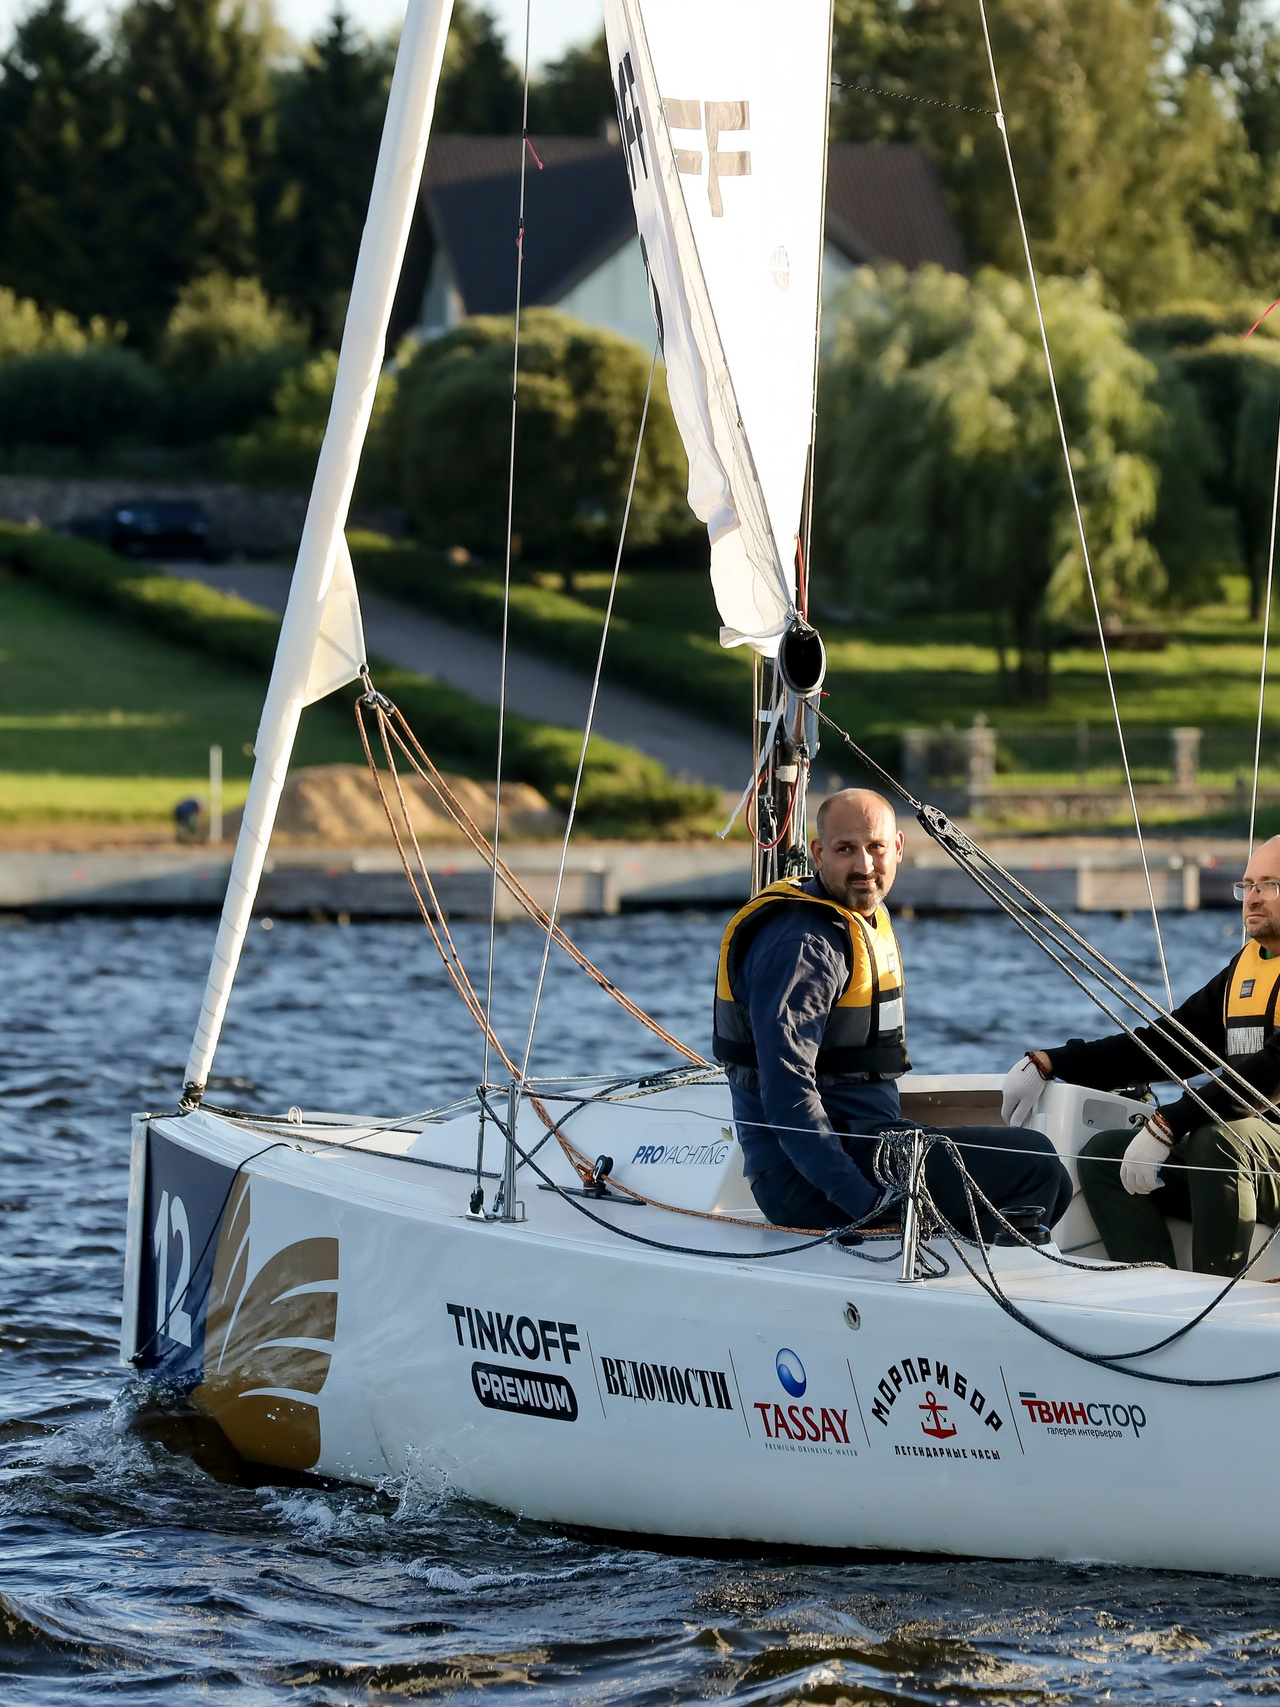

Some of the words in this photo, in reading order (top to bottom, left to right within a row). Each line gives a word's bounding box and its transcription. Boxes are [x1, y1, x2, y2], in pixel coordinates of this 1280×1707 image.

[631, 1145, 729, 1164] PROYACHTING
[153, 1189, 192, 1348] 12
[446, 1302, 581, 1365] TINKOFF
[476, 1370, 572, 1413] PREMIUM
[600, 1355, 734, 1411] ВЕДОМОСТИ
[871, 1356, 1003, 1432] МОРПРИБОР
[753, 1402, 851, 1444] TASSAY
[1046, 1426, 1077, 1436] галерея
[1078, 1428, 1123, 1439] интерьеров
[765, 1442, 796, 1452] PREMIUM
[798, 1445, 833, 1455] DRINKING
[836, 1448, 859, 1457] WATER
[894, 1445, 968, 1459] ЛЕГЕНДАРНЫЕ
[971, 1449, 1001, 1461] ЧАСЫ
